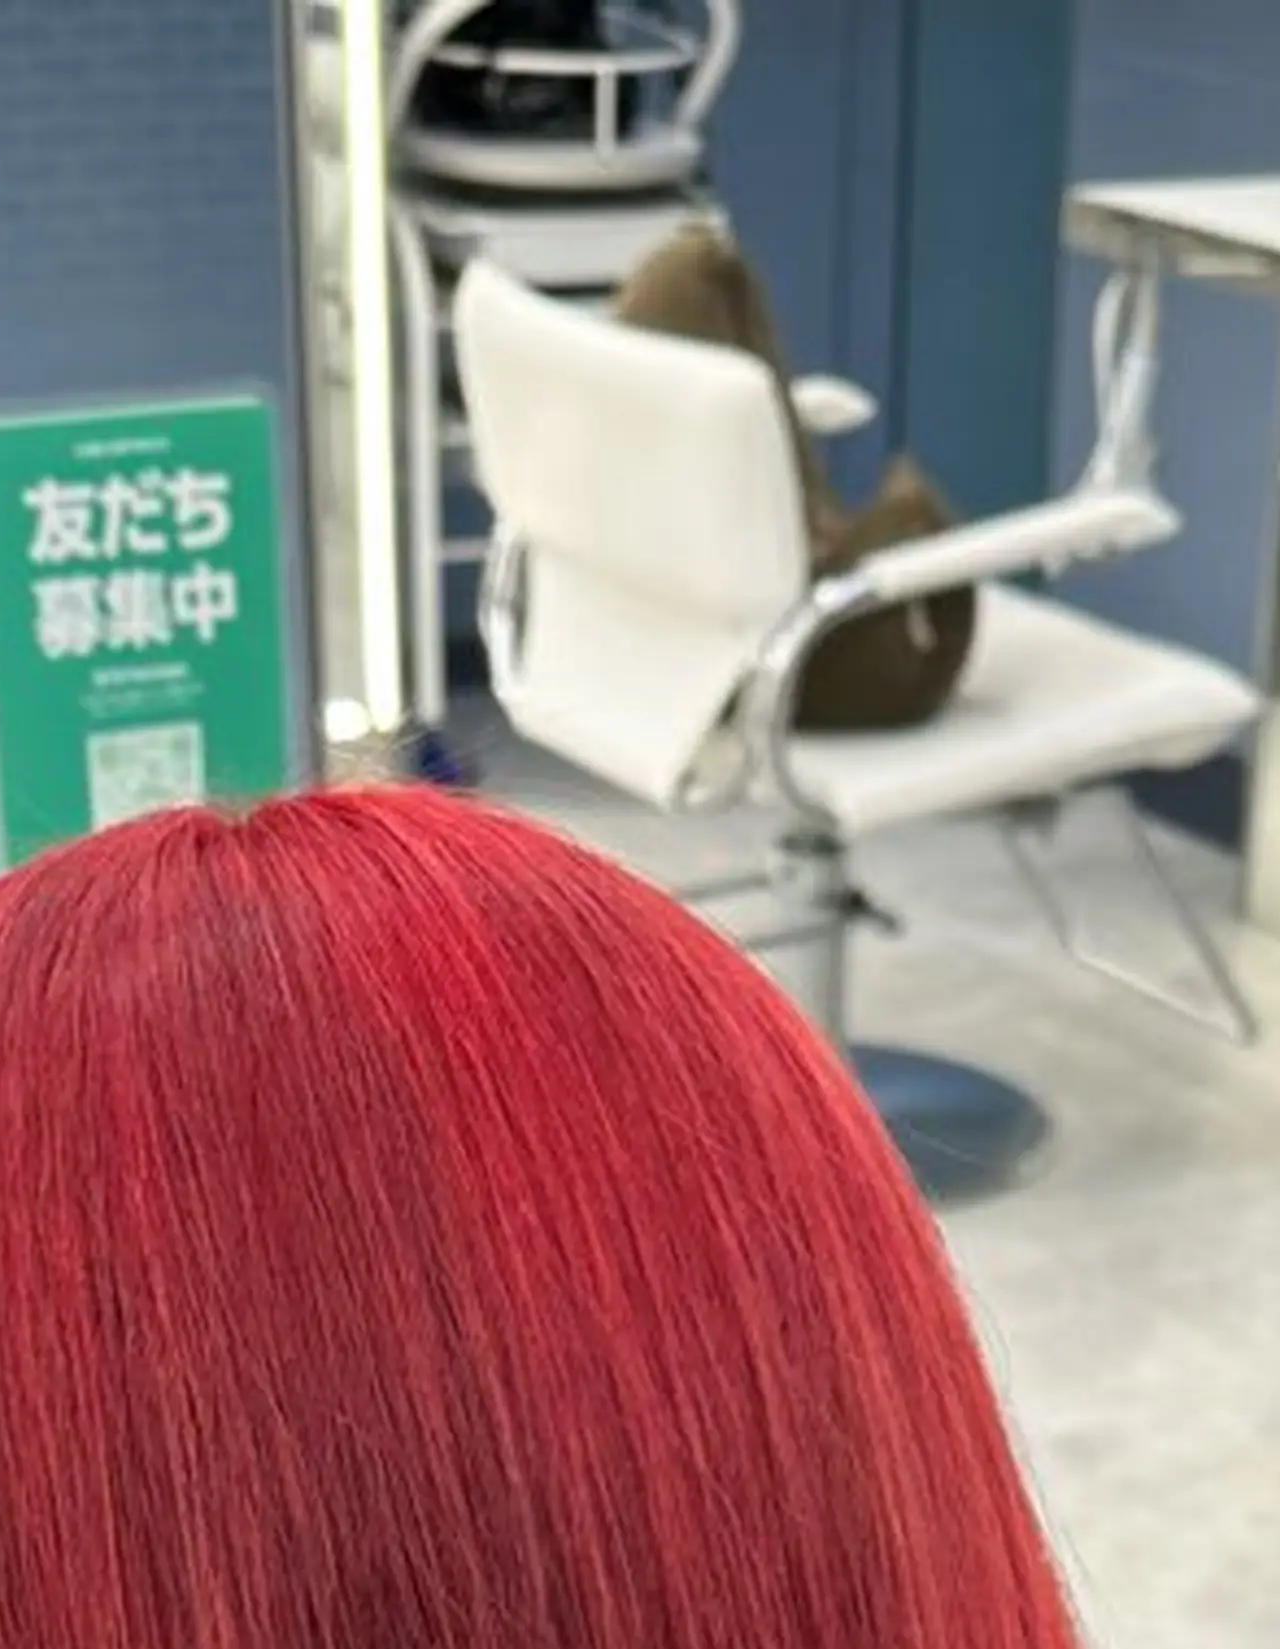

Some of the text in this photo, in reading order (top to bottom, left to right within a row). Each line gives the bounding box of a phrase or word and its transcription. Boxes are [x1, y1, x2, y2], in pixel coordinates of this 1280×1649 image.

[22, 467, 231, 563] 友だち
[31, 561, 237, 658] 募集中
